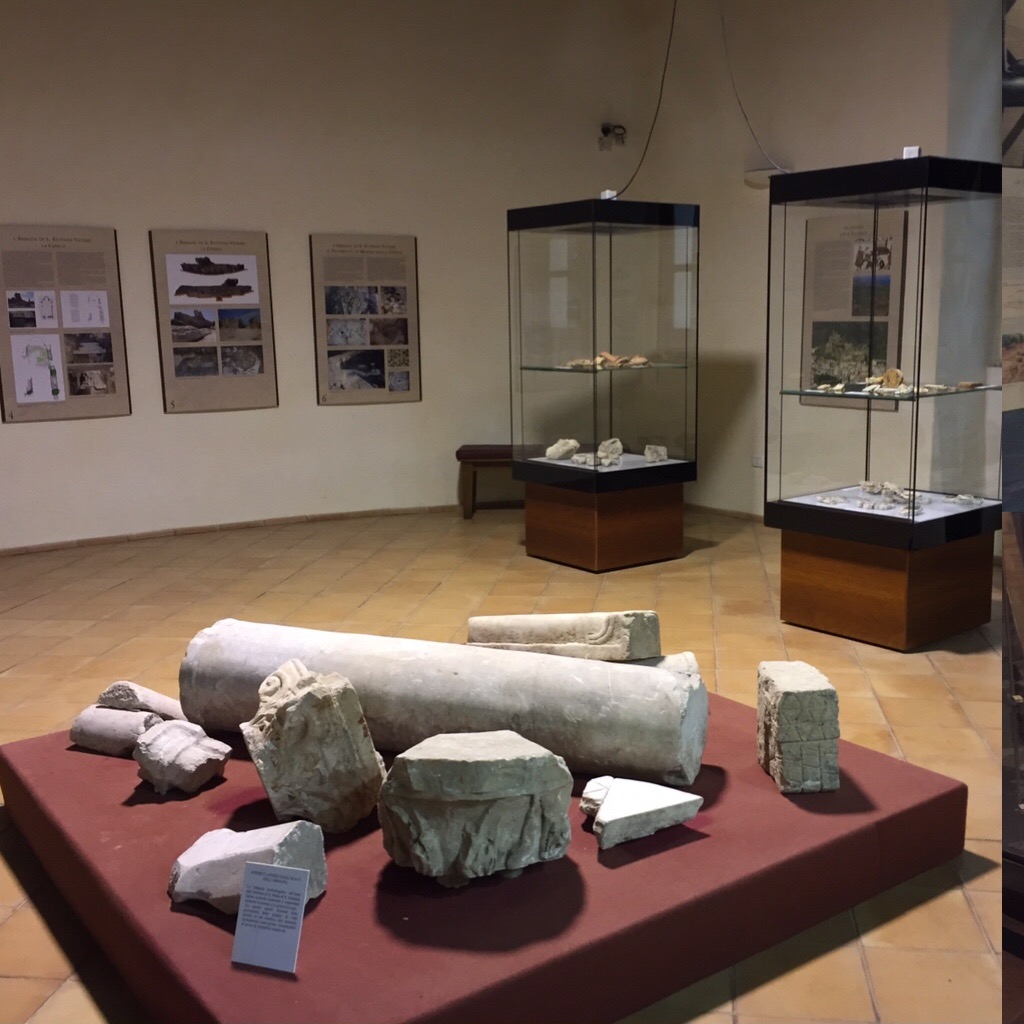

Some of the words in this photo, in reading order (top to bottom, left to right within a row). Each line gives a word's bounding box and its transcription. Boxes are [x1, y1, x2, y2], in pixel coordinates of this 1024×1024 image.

[321, 393, 327, 403] 6
[169, 400, 175, 410] 5
[8, 409, 14, 420] 4
